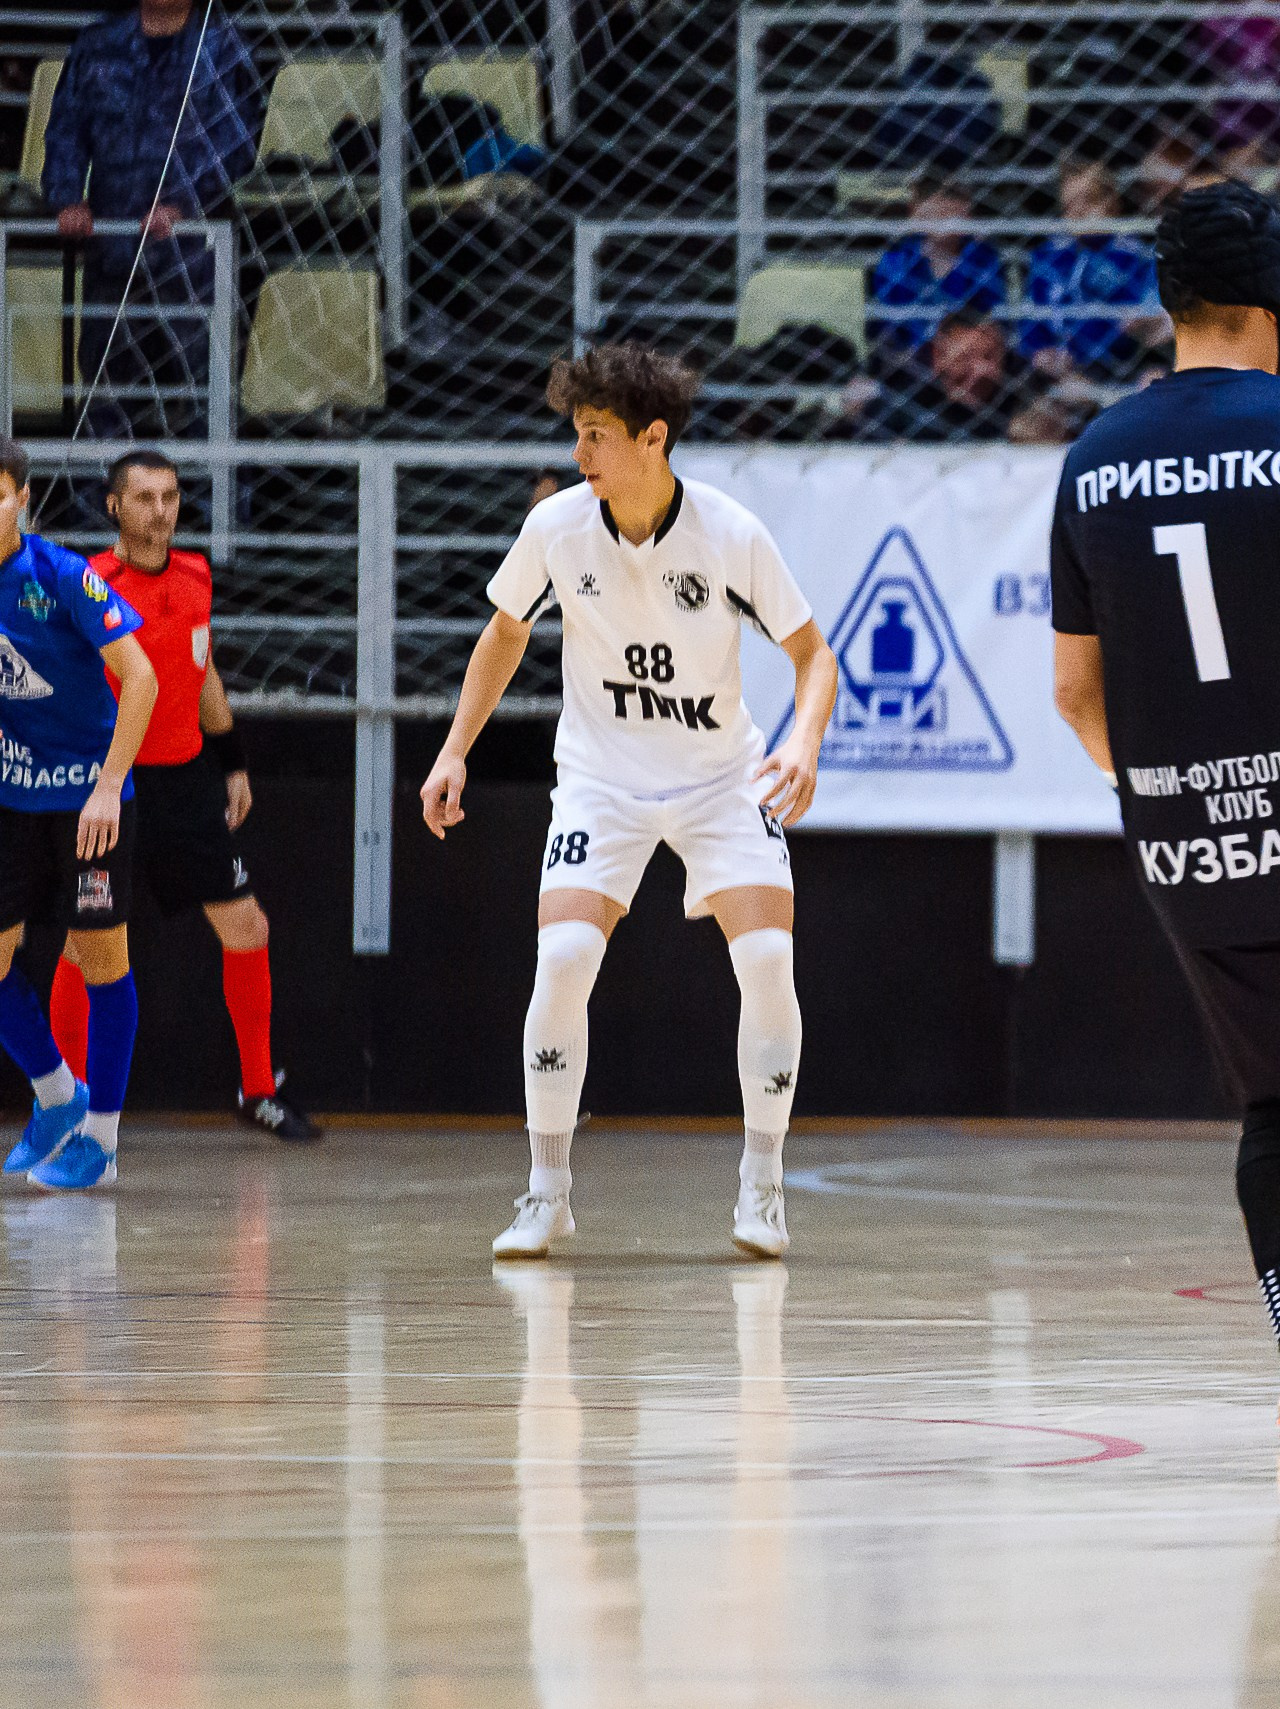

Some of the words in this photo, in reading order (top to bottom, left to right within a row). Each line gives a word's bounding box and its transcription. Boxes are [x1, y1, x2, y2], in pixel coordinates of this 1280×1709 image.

[1152, 522, 1231, 682] 1
[625, 643, 675, 683] 88
[602, 679, 722, 731] ТМК
[2, 760, 102, 789] УЗБАССА
[1205, 788, 1273, 824] КЛУБ
